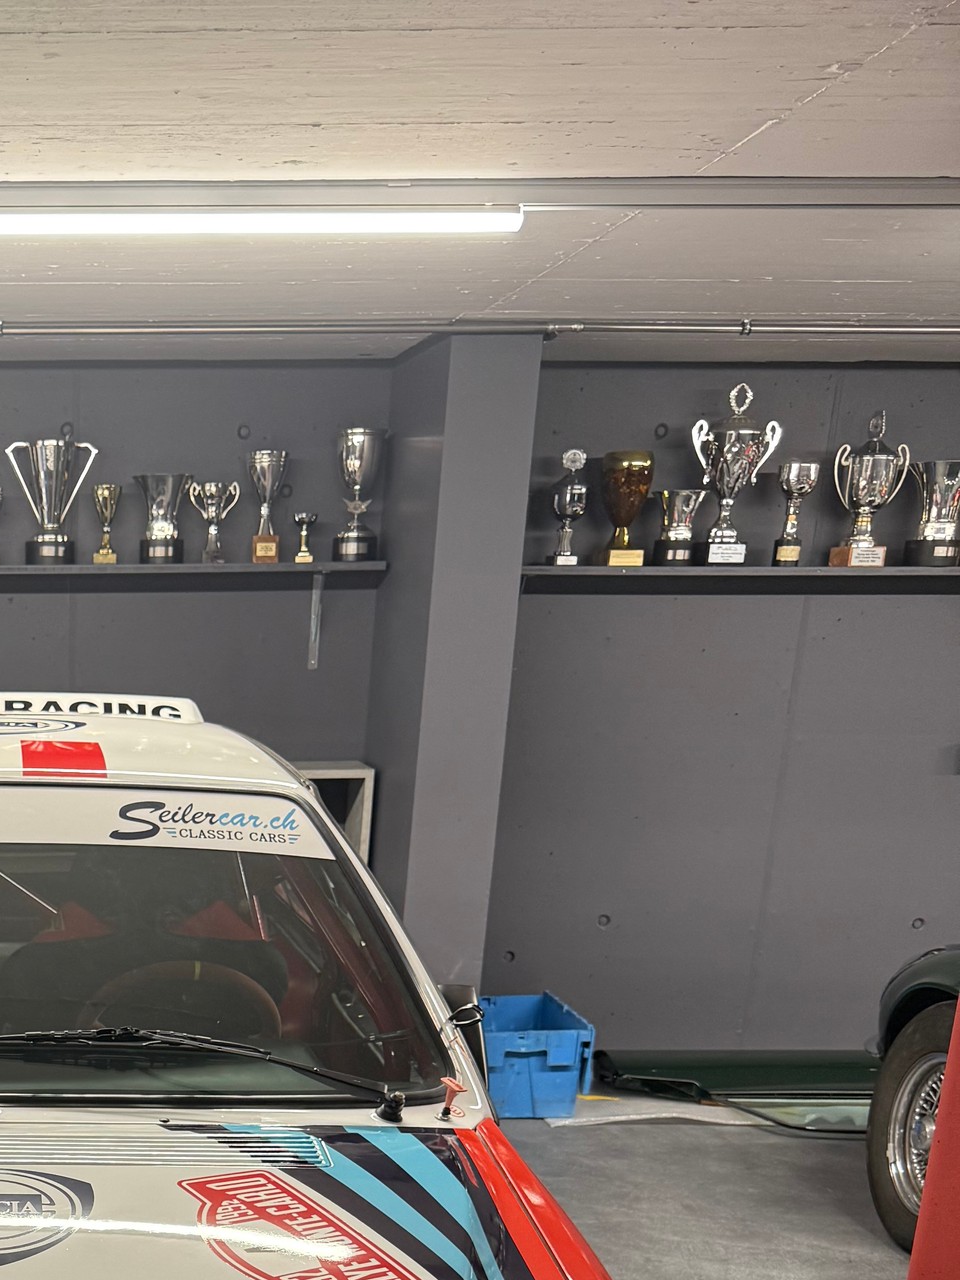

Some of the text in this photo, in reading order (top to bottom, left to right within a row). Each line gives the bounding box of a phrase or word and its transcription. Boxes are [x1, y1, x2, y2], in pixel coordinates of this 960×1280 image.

[109, 801, 299, 840] Seilercar.ch
[179, 828, 287, 844] CLASSIC CARS
